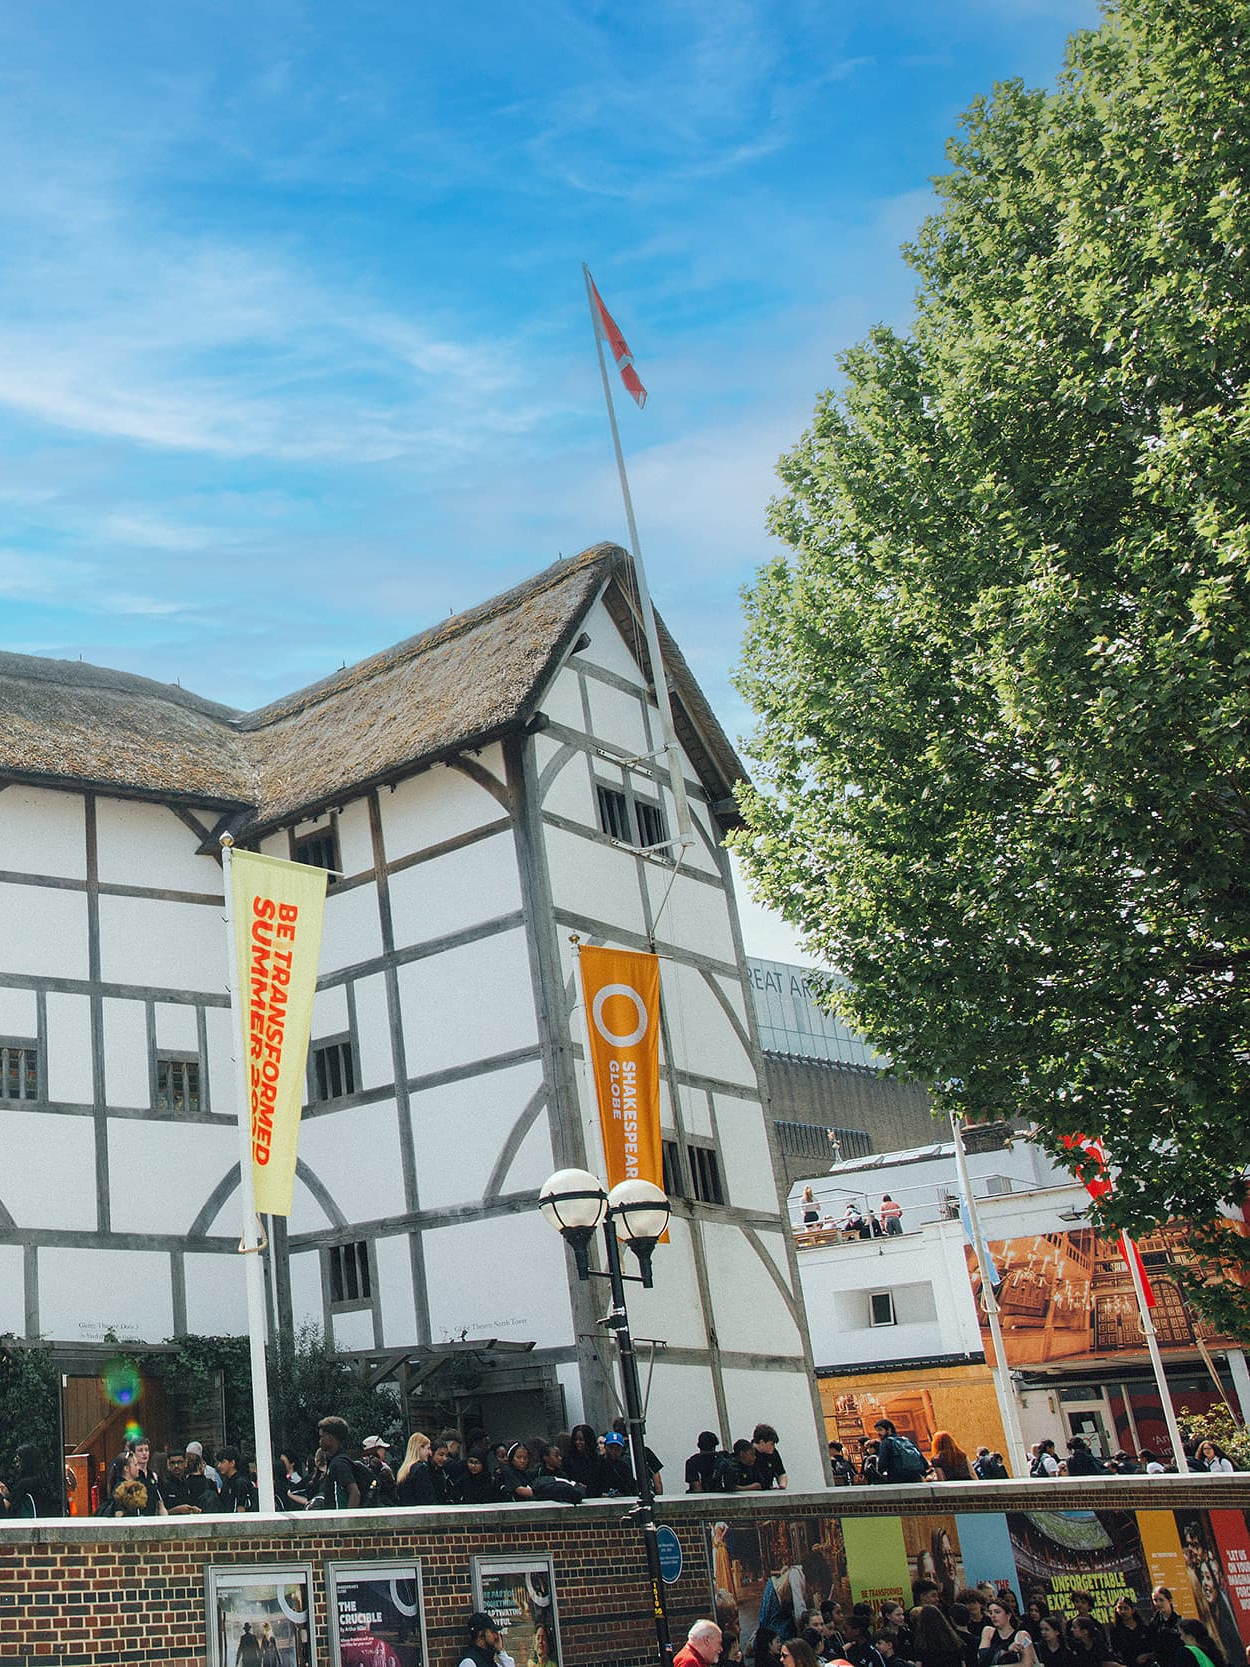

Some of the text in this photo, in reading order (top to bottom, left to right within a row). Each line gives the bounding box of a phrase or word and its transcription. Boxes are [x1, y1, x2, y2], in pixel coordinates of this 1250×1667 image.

[251, 895, 276, 1060] SUMMER
[256, 904, 297, 1166] BE TRANSFORMED
[609, 1060, 622, 1120] GLOBE
[1051, 1572, 1126, 1592] UNFORGETTABLE
[338, 1601, 357, 1612] THE
[339, 1612, 383, 1625] CRUCIBLE
